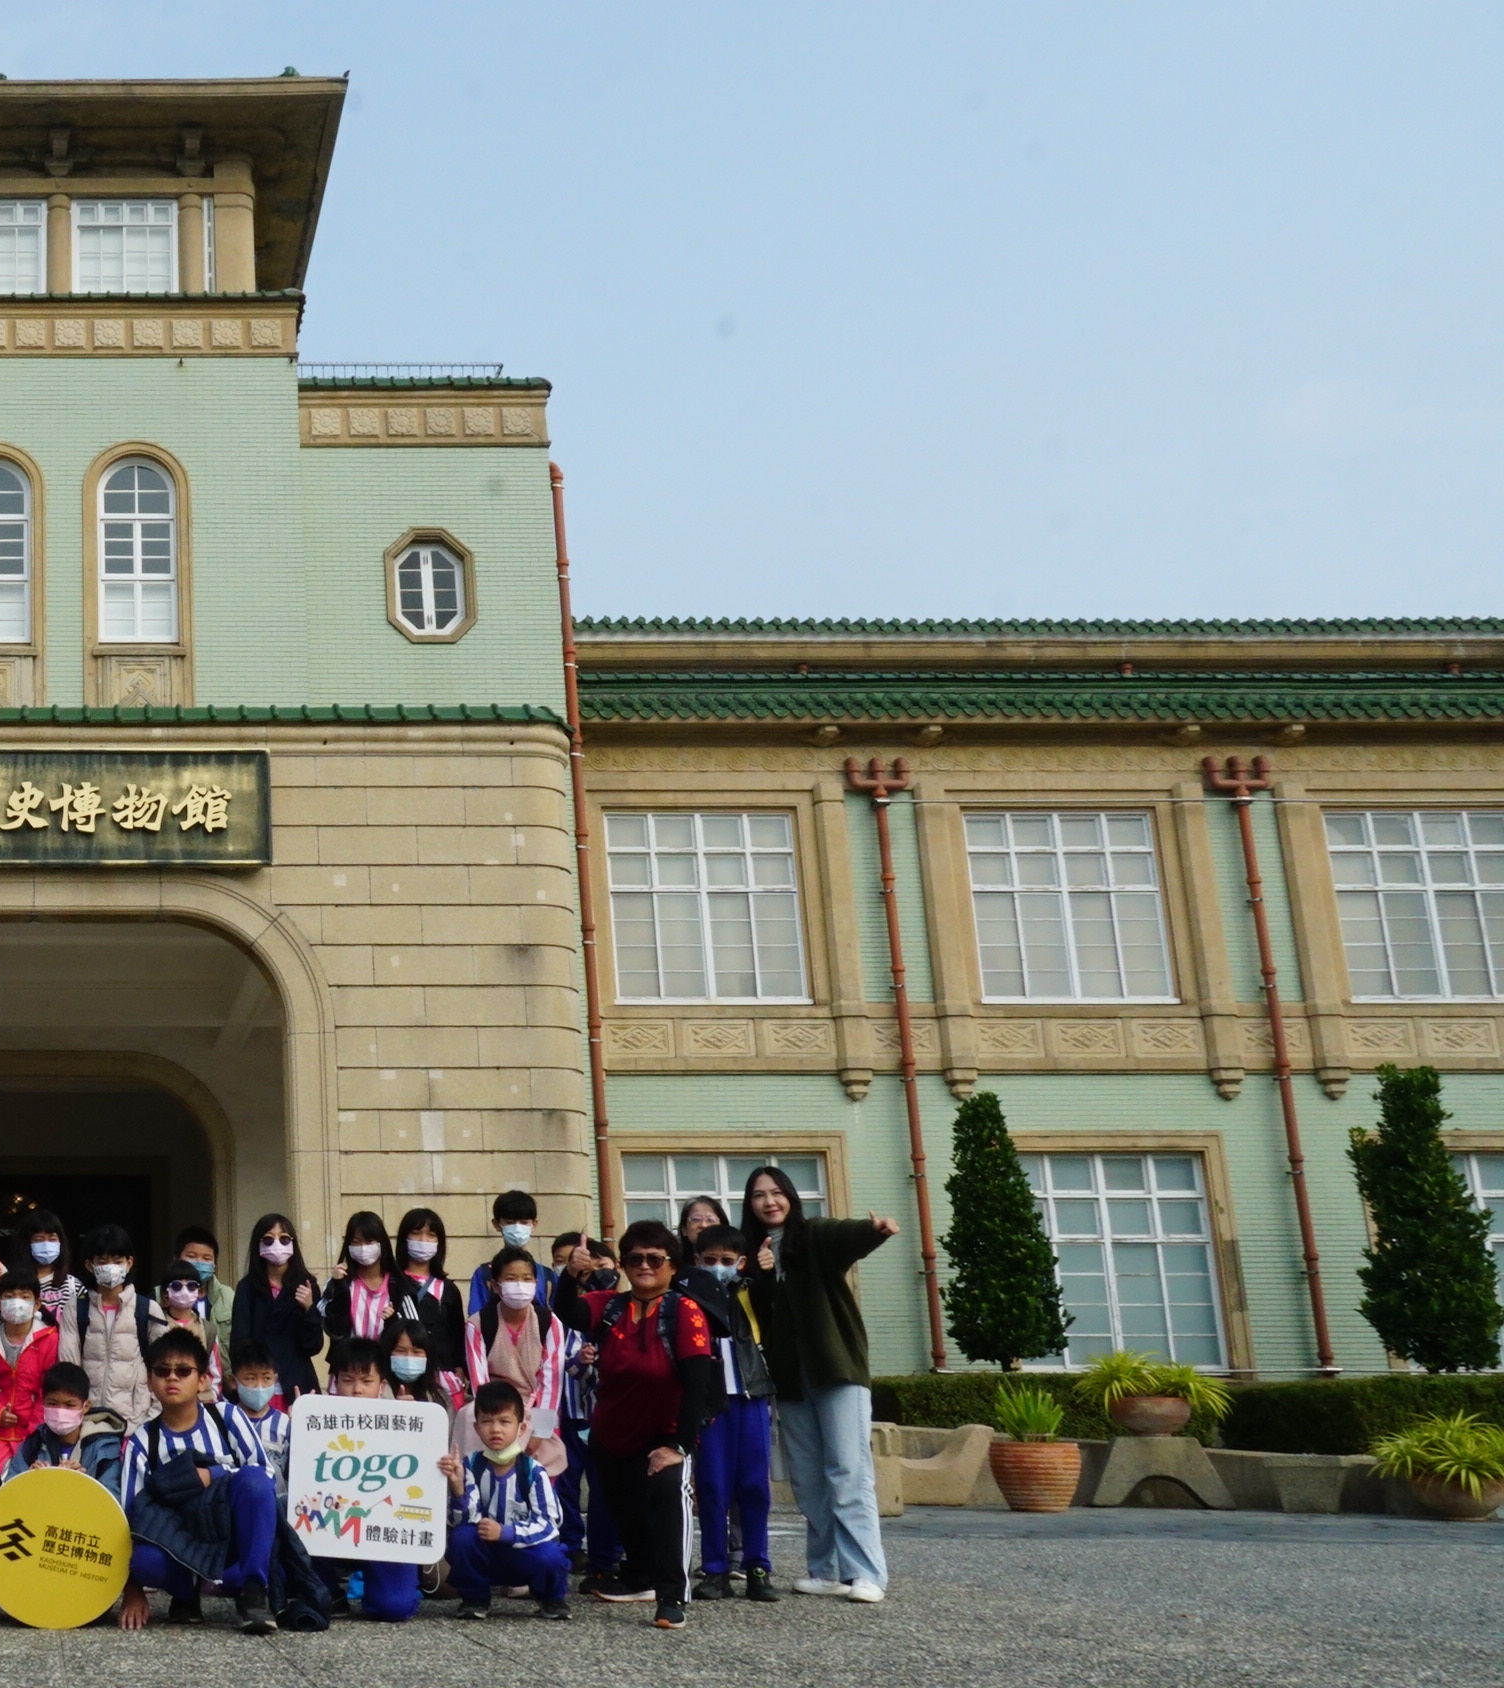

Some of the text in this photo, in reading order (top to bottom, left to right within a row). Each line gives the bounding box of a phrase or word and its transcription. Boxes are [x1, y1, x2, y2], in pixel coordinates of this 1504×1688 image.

[305, 1413, 424, 1432] 高雄市校園藝術
[314, 1451, 419, 1493] togo
[44, 1525, 101, 1549] 高雄市立
[365, 1525, 435, 1547] 體驗計畫
[40, 1557, 78, 1570] KAOHSIUNG
[42, 1539, 113, 1567] 歷史博物館
[38, 1563, 68, 1575] MUSEUM
[80, 1572, 109, 1583] HISTORY
